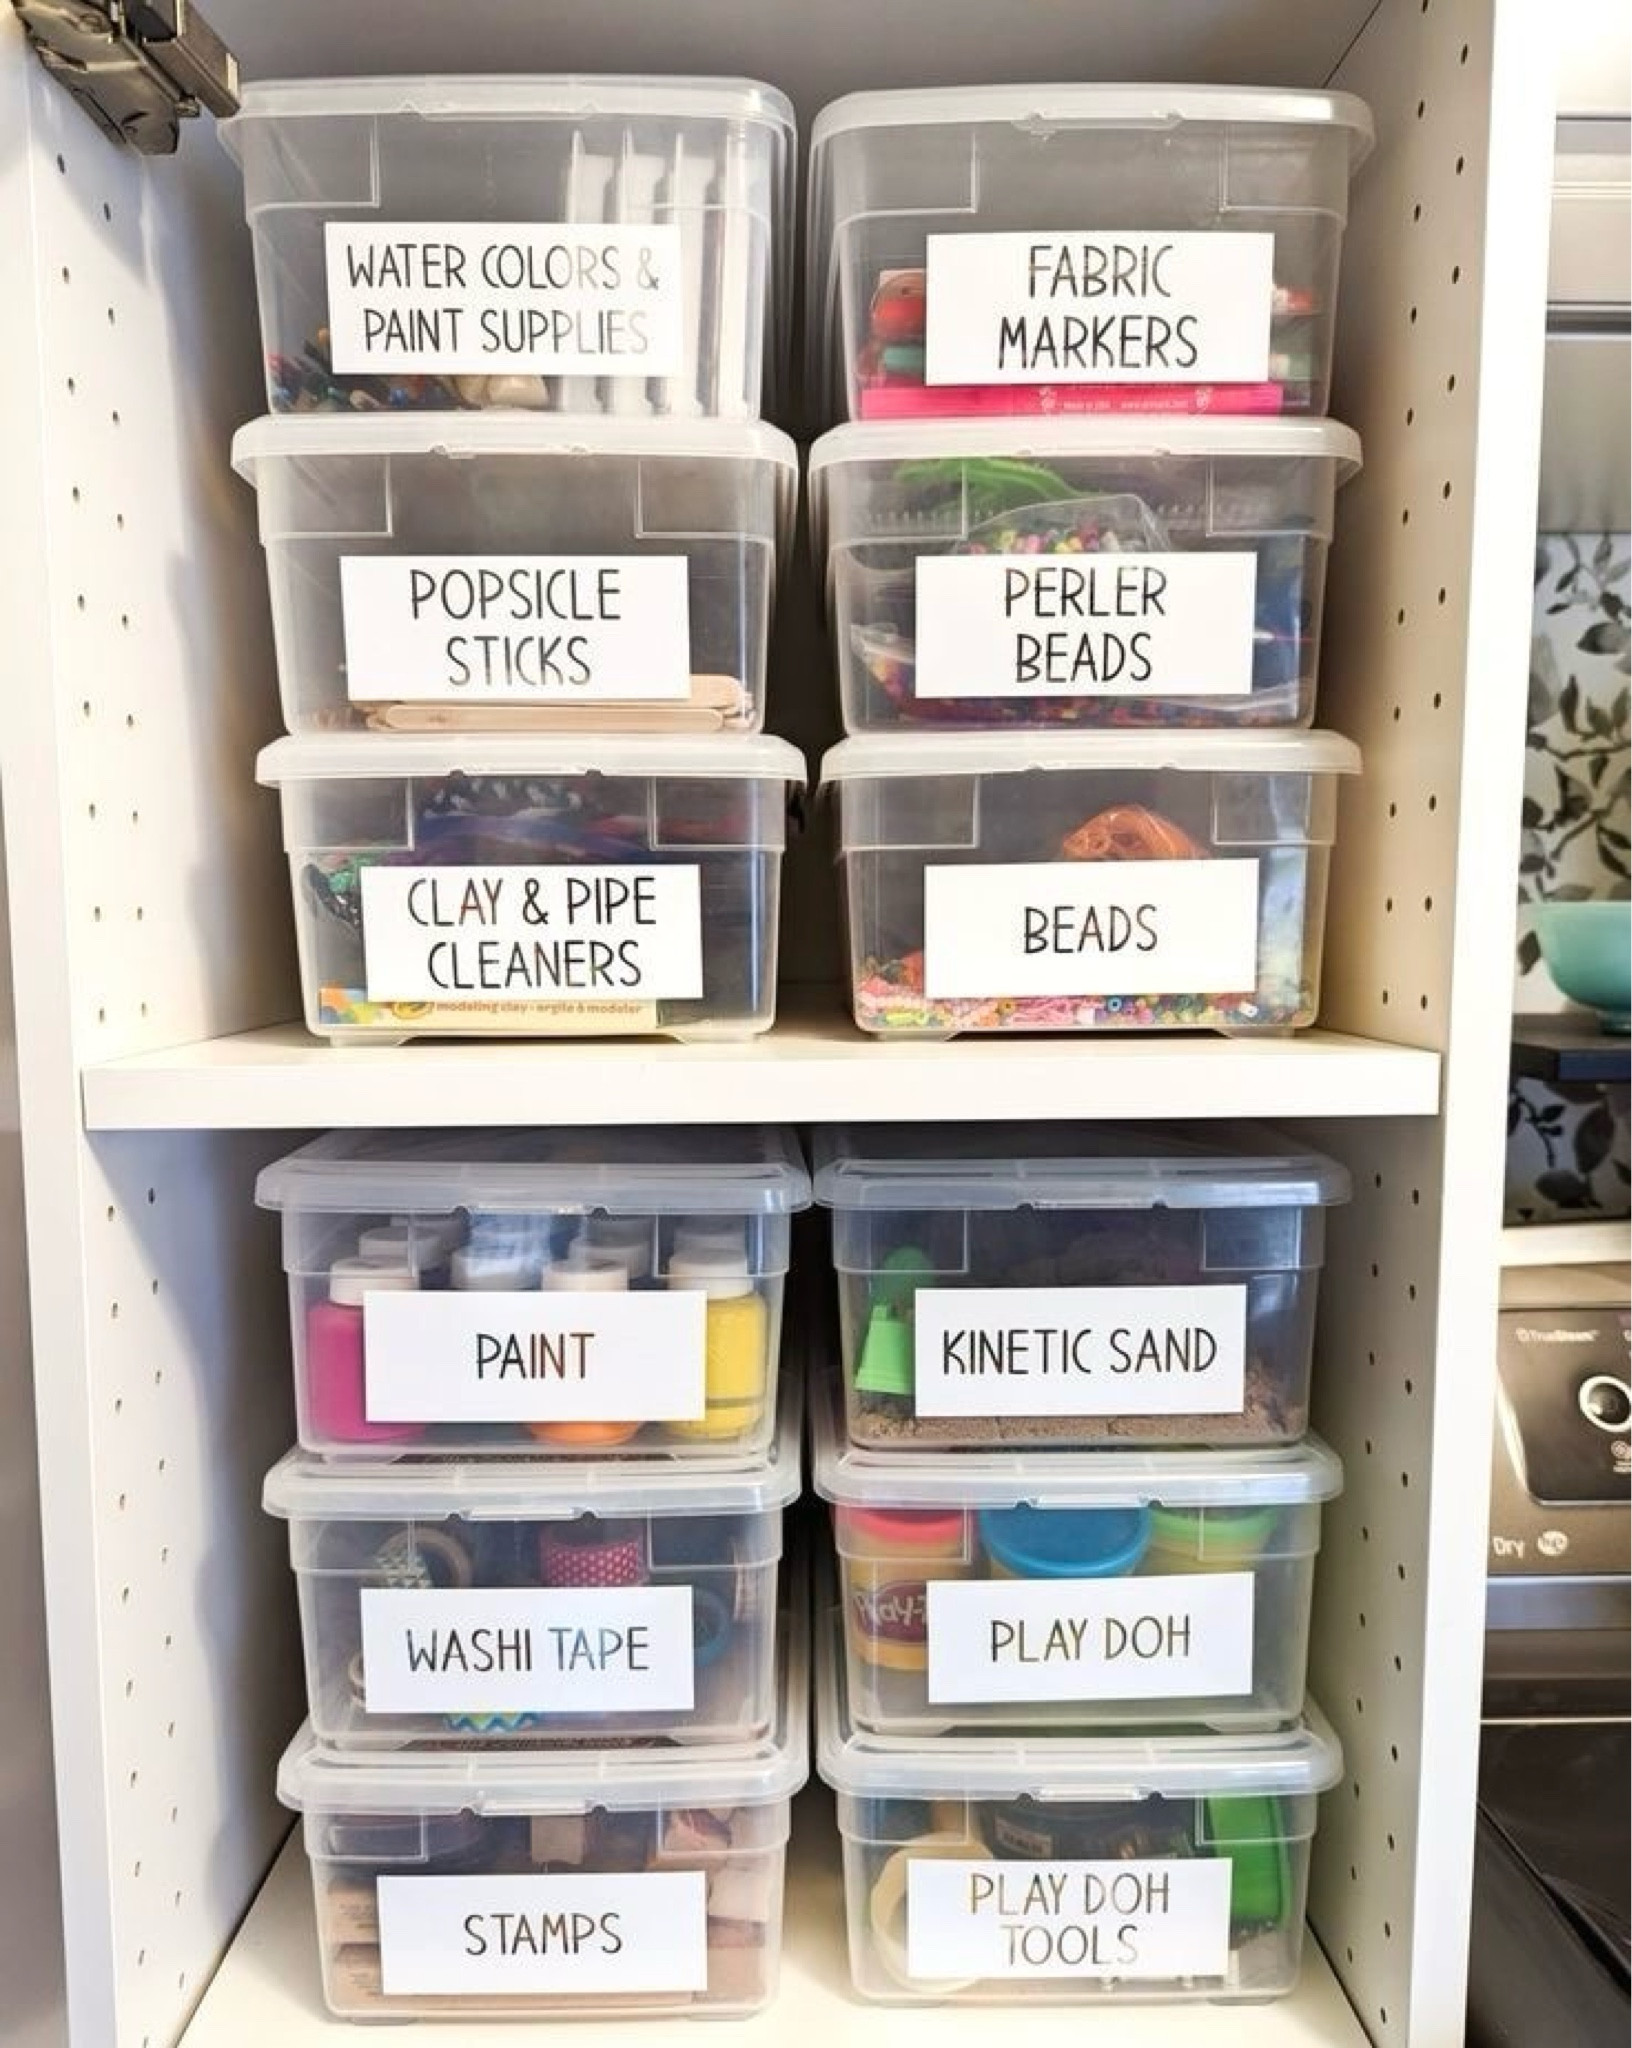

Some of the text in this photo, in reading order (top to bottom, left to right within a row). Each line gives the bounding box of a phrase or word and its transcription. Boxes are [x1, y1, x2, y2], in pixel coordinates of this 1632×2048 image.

[346, 243, 661, 291] WATER COLORS &
[1028, 244, 1173, 299] FABRIC
[363, 308, 647, 354] PAINT SUPPLIES
[998, 315, 1197, 370] MARKERS
[410, 569, 621, 621] POPSICLE
[1004, 566, 1167, 618] PERLER
[446, 636, 591, 686] STICKS
[1015, 632, 1152, 683] BEADS
[407, 875, 656, 927] CLAY & PIPE
[1024, 904, 1157, 955] BEADS
[428, 939, 641, 989] CLEANERS
[436, 1001, 498, 1014] modeling
[501, 1001, 528, 1014] clay
[476, 1332, 596, 1380] PAINT
[943, 1327, 1217, 1375] KINETIC SAND
[1493, 1536, 1525, 1559] Dry
[406, 1626, 649, 1672] WASHI TAPE
[991, 1614, 1190, 1662] PLAY DOH
[971, 1873, 1169, 1915] PLAY DOH
[463, 1912, 623, 1956] STAMPS
[1002, 1924, 1137, 1965] TOOLS
